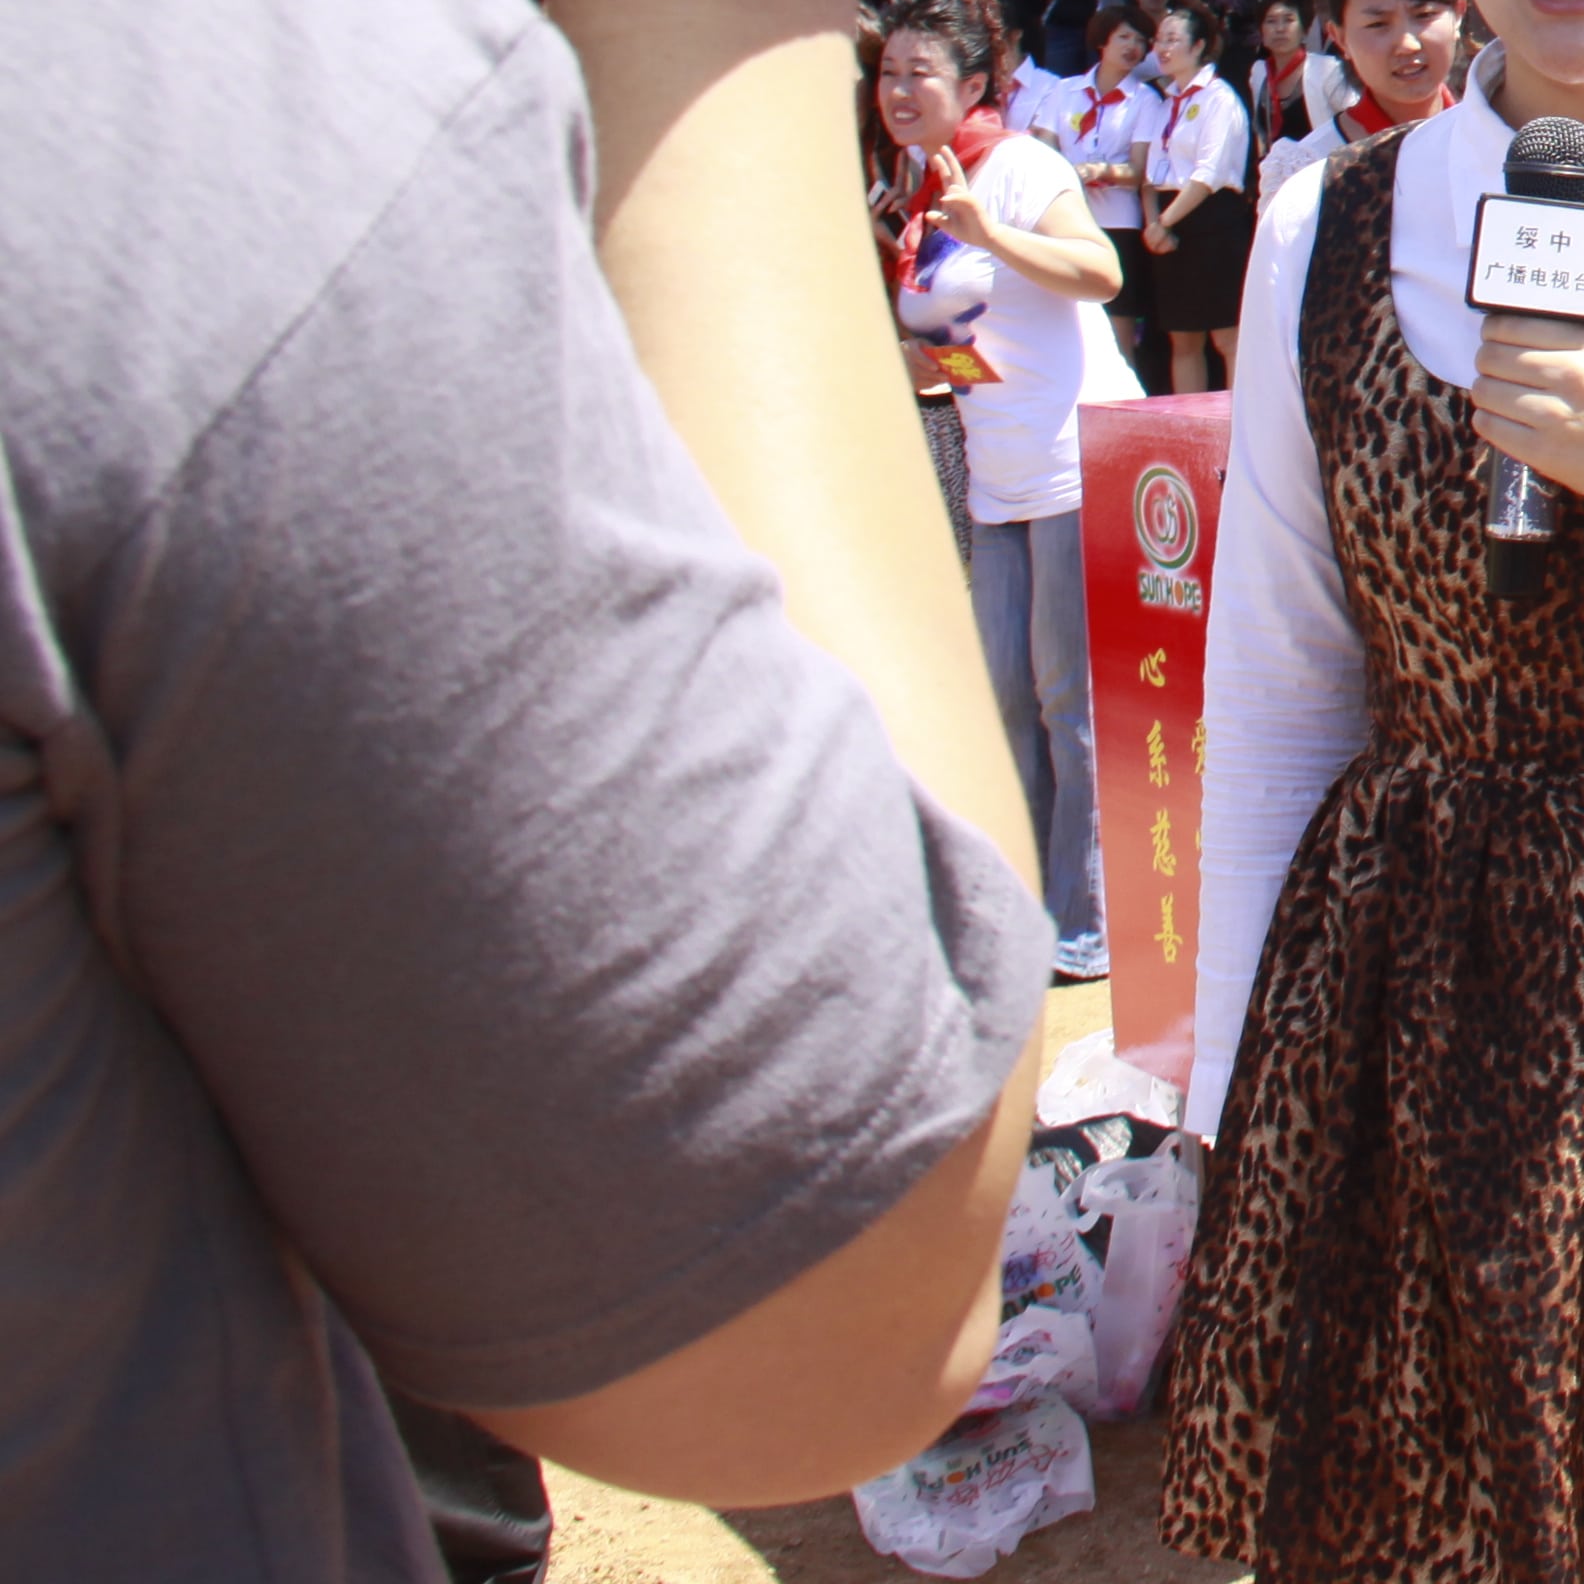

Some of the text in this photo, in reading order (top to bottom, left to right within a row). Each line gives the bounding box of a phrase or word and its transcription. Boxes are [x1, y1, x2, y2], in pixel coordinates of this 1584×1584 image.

[1514, 225, 1572, 254] 绥中
[1138, 572, 1203, 612] SUN HOPE
[1138, 647, 1184, 964] 心系慈善
